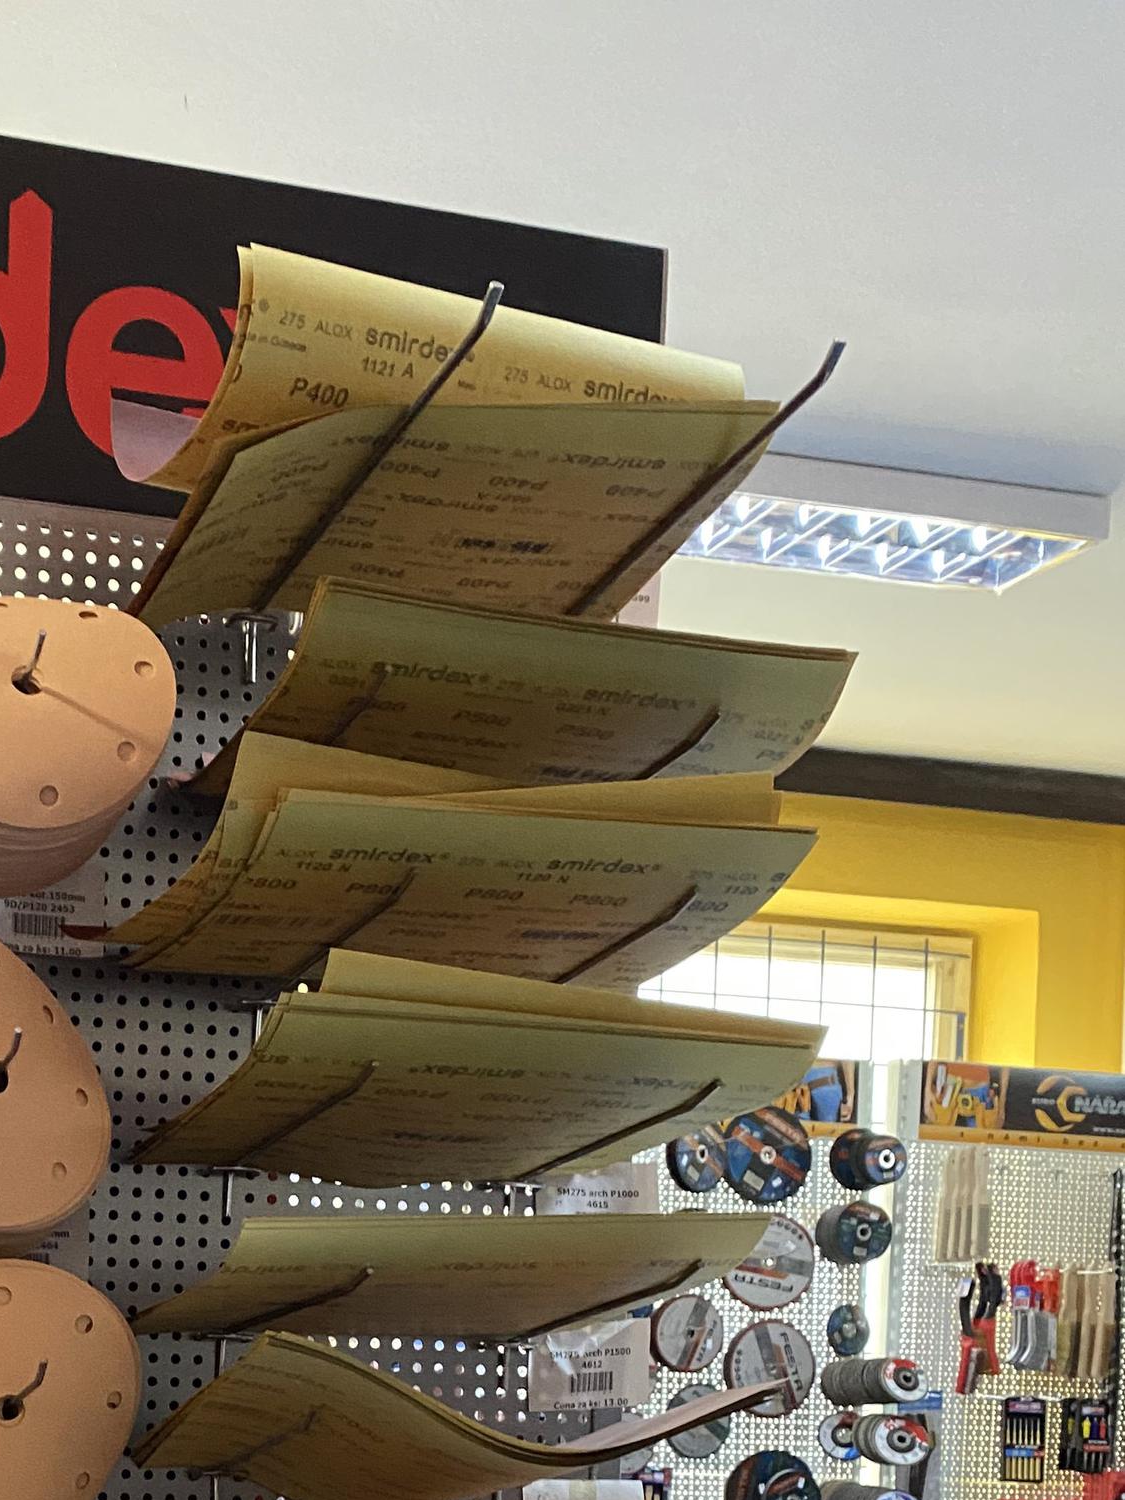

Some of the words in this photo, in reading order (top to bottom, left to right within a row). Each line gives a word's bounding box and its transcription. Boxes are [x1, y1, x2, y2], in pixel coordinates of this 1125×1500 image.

[279, 311, 305, 329] 275
[314, 320, 353, 341] ALOX
[365, 327, 463, 362] smirde
[402, 363, 414, 378] A
[504, 366, 528, 383] 275
[537, 374, 571, 392] ALOX
[289, 377, 349, 408] P400
[329, 848, 433, 865] smirdex
[611, 1189, 639, 1198] P1000
[779, 1332, 804, 1391] FESTA
[554, 1401, 575, 1410] Cena
